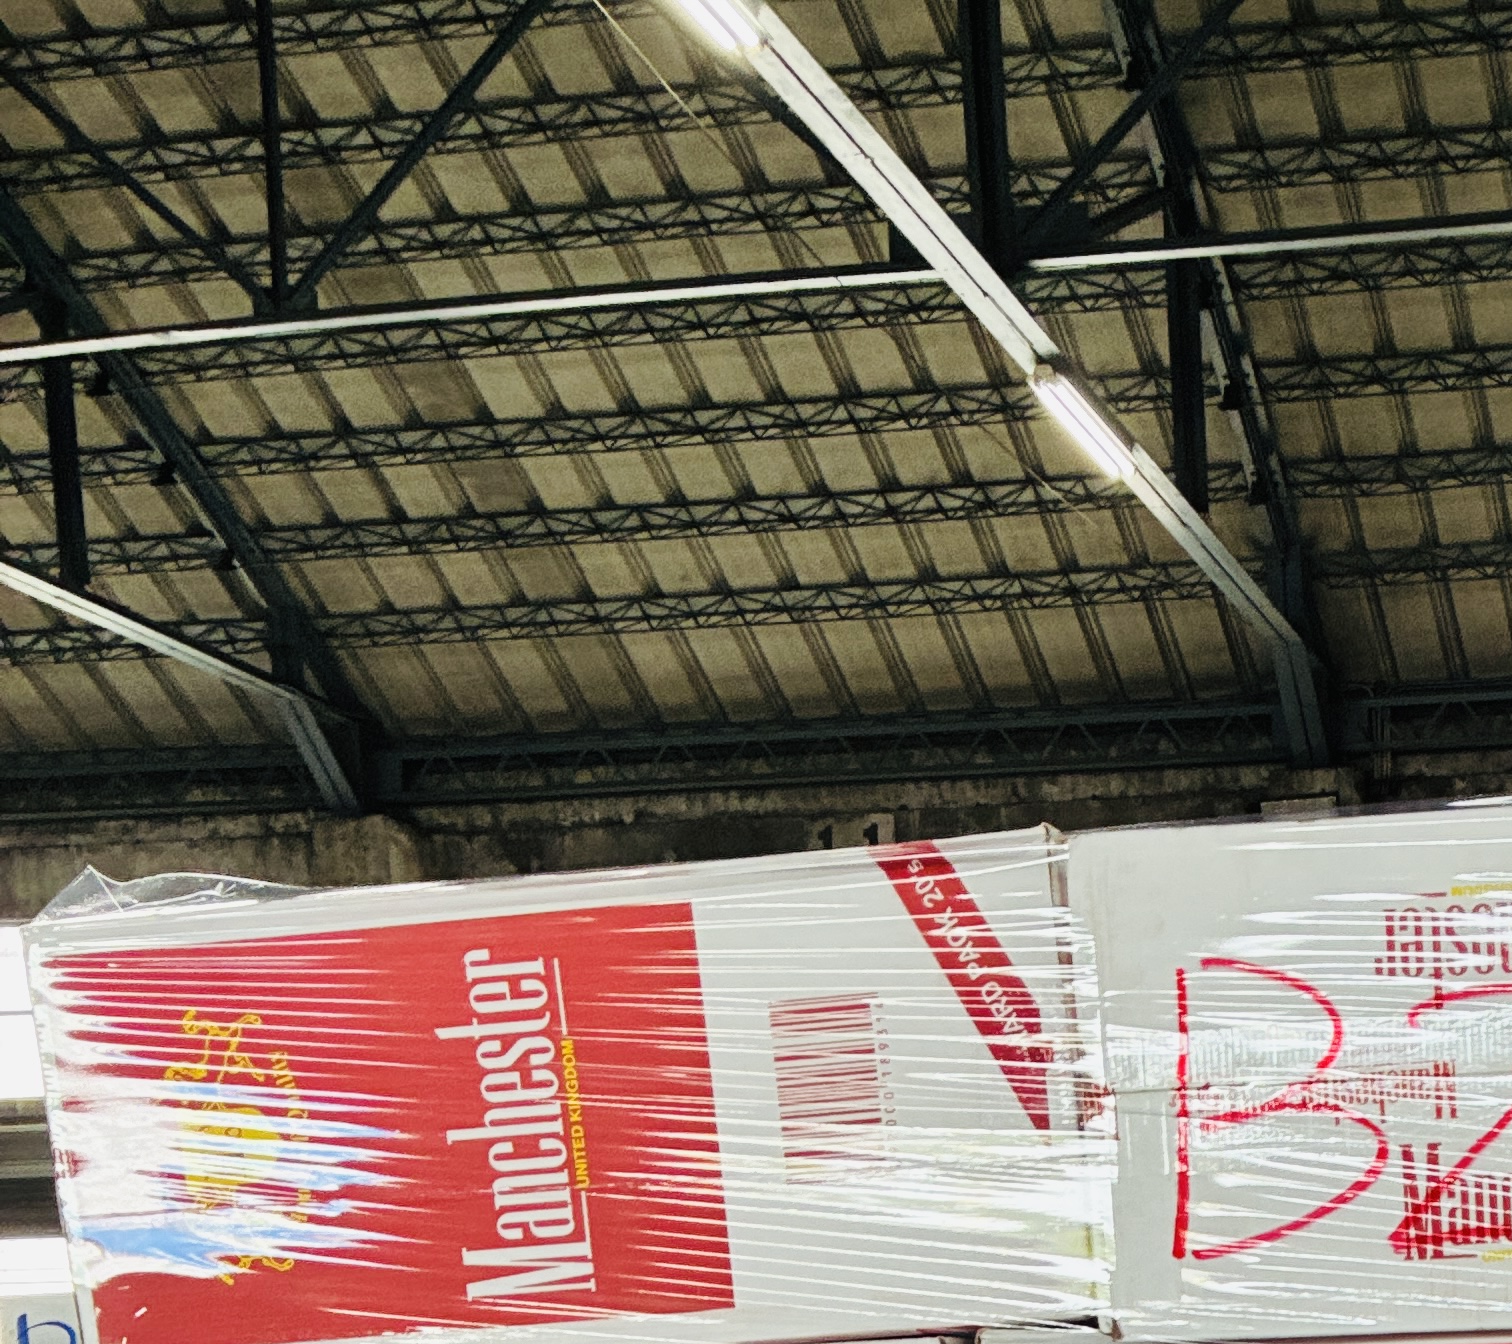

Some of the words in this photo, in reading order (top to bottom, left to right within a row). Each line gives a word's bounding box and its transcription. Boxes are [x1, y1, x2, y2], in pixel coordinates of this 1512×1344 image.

[562, 1037, 586, 1124] KINGDOM
[434, 948, 597, 1301] Manchester
[572, 1124, 591, 1190] UNITED
